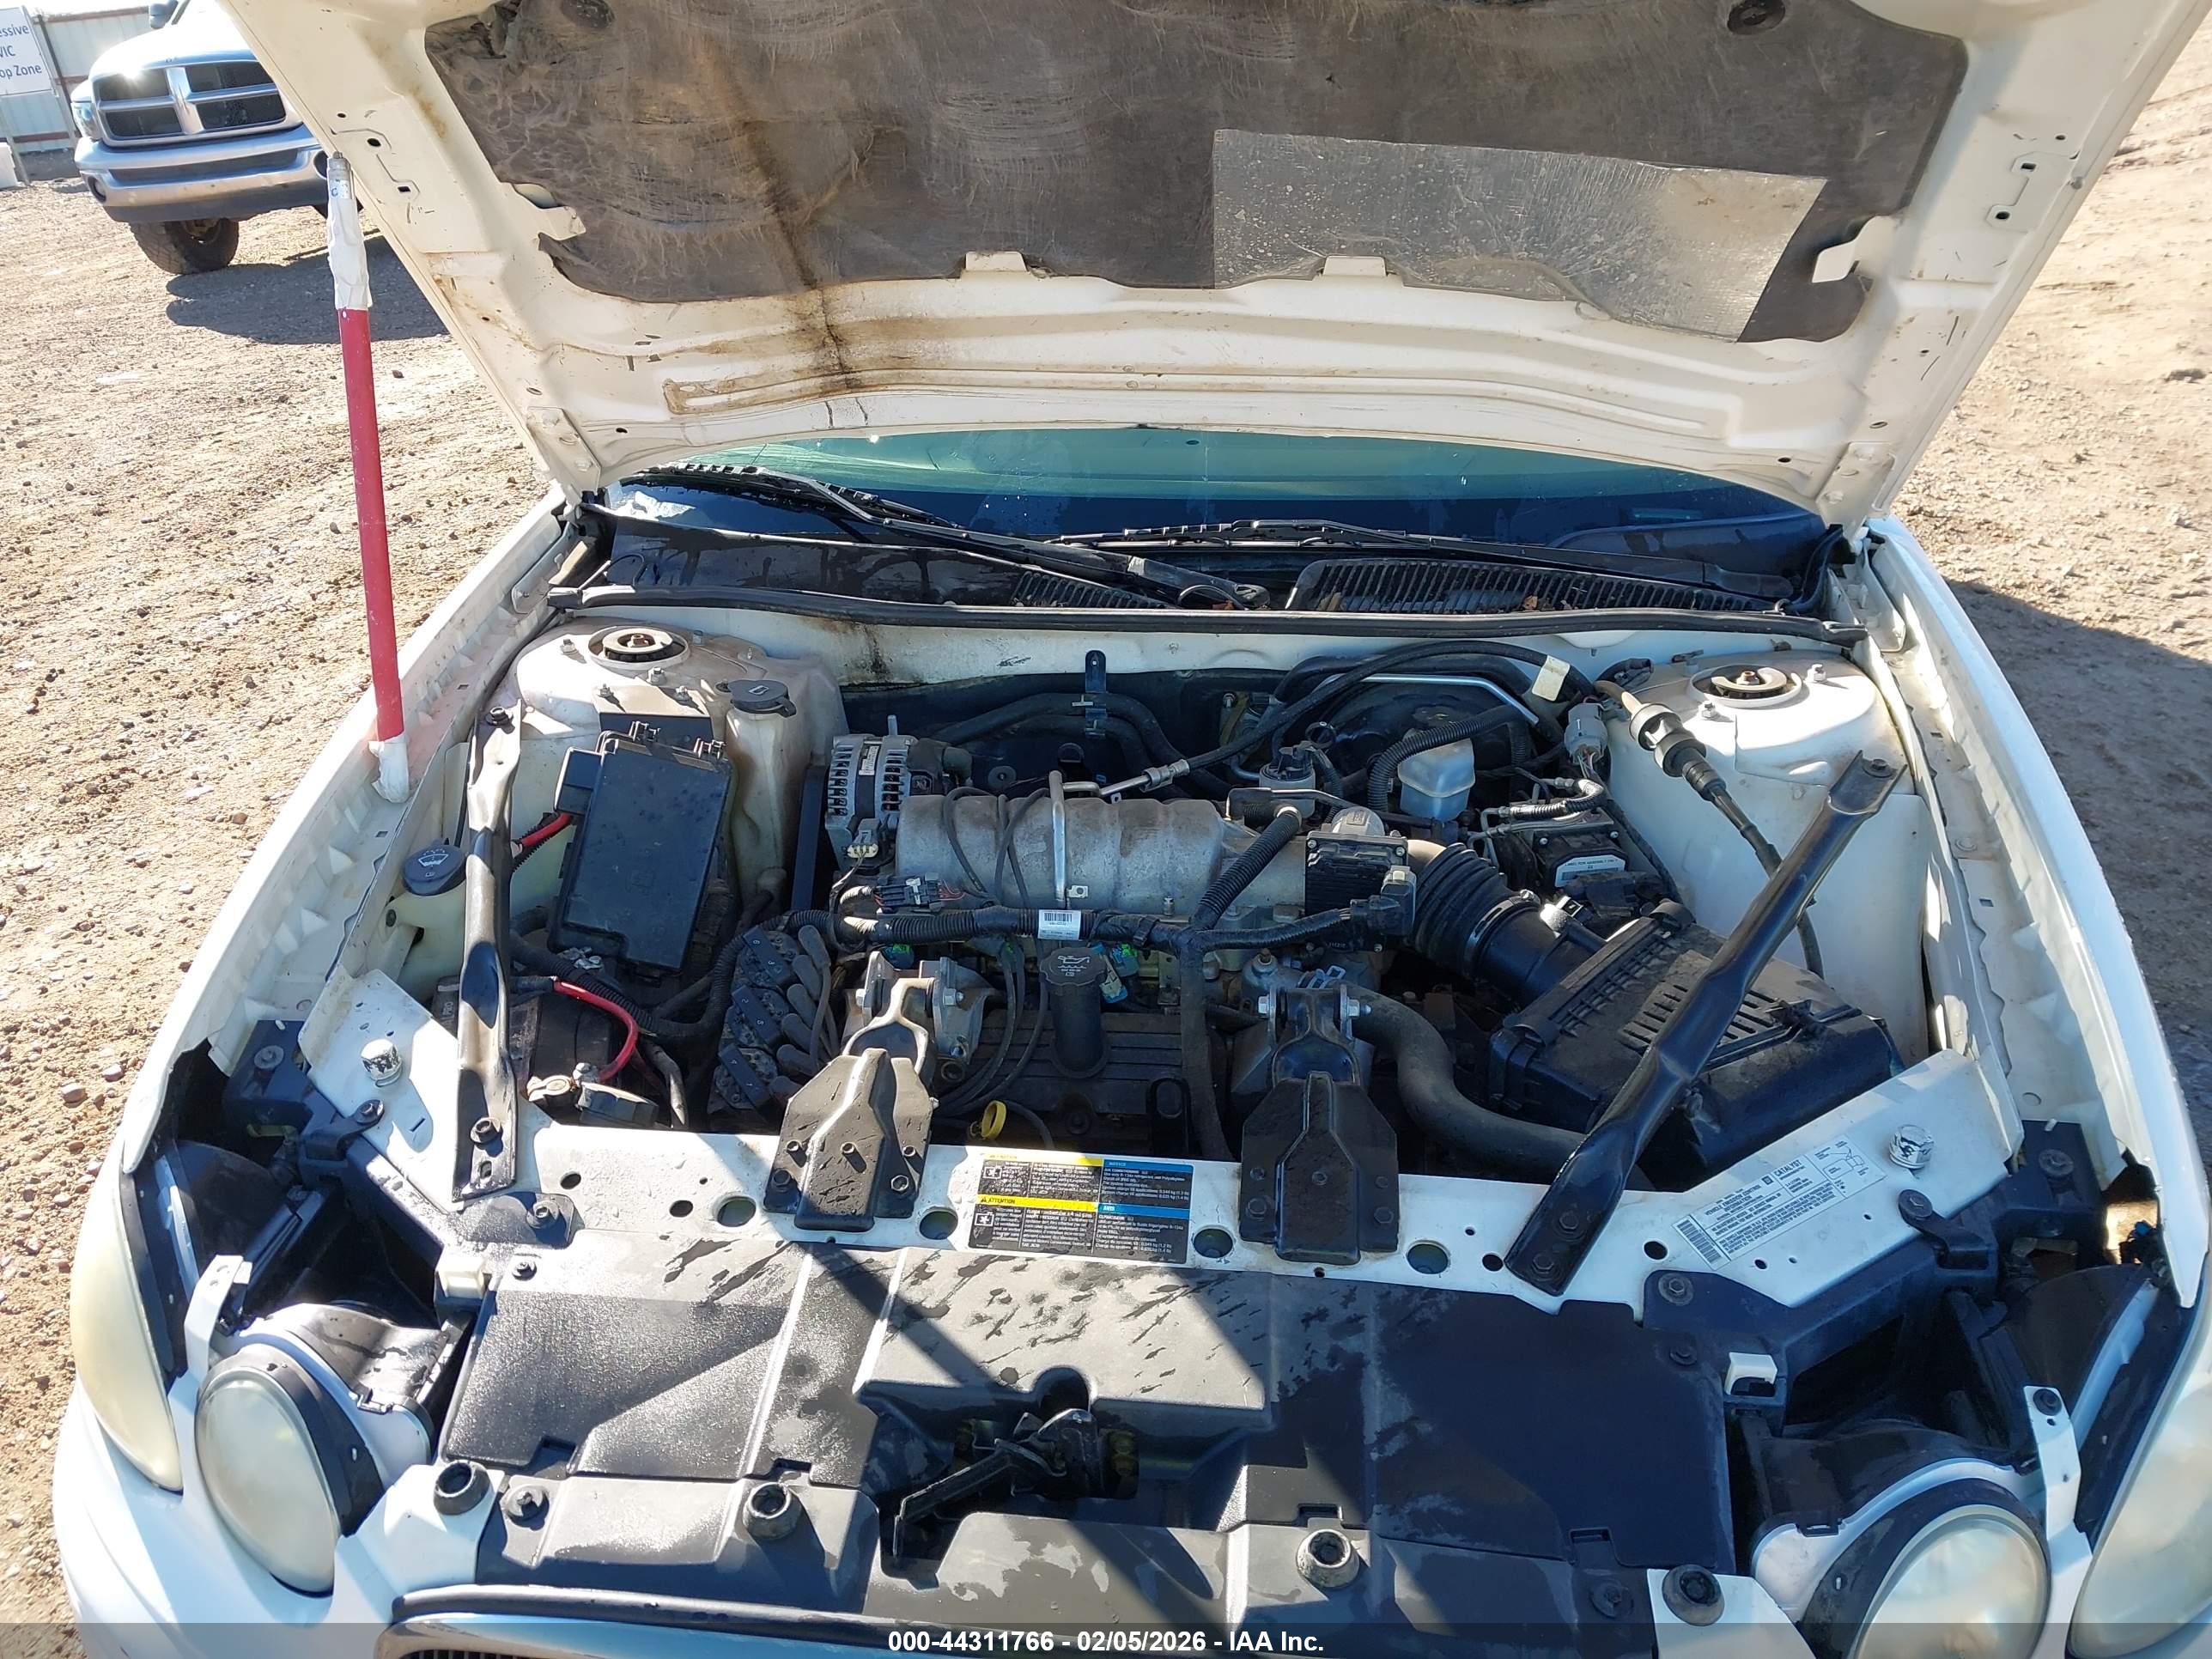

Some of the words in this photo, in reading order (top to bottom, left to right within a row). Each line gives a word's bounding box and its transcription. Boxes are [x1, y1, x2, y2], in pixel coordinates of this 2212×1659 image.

[14, 64, 42, 76] Zone
[1773, 1159, 1802, 1177] CATALYST
[1741, 1184, 1761, 1196] CONTROL
